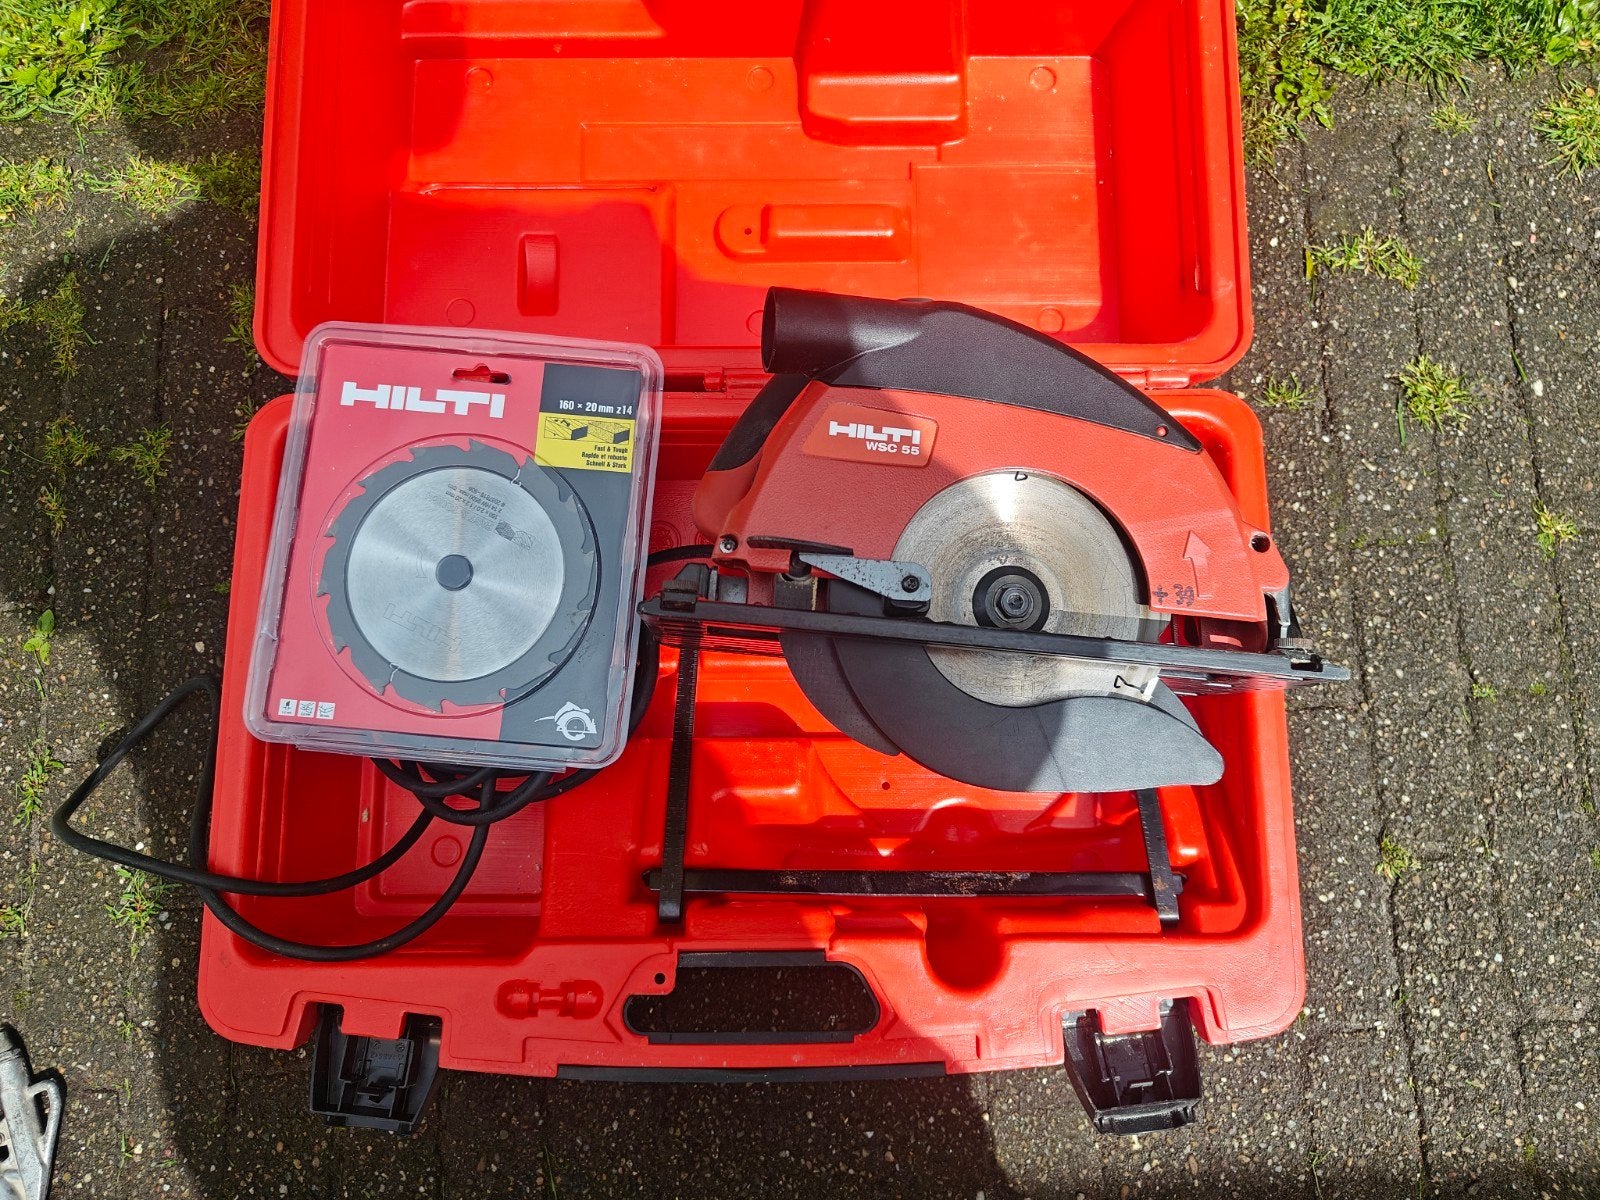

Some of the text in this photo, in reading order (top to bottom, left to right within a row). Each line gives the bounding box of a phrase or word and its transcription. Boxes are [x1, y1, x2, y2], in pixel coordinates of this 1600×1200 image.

[340, 381, 505, 418] HILTI
[560, 400, 574, 410] 160
[585, 402, 597, 412] 20
[598, 405, 614, 413] mm
[828, 420, 920, 444] HILTI
[866, 441, 920, 455] WSC 55
